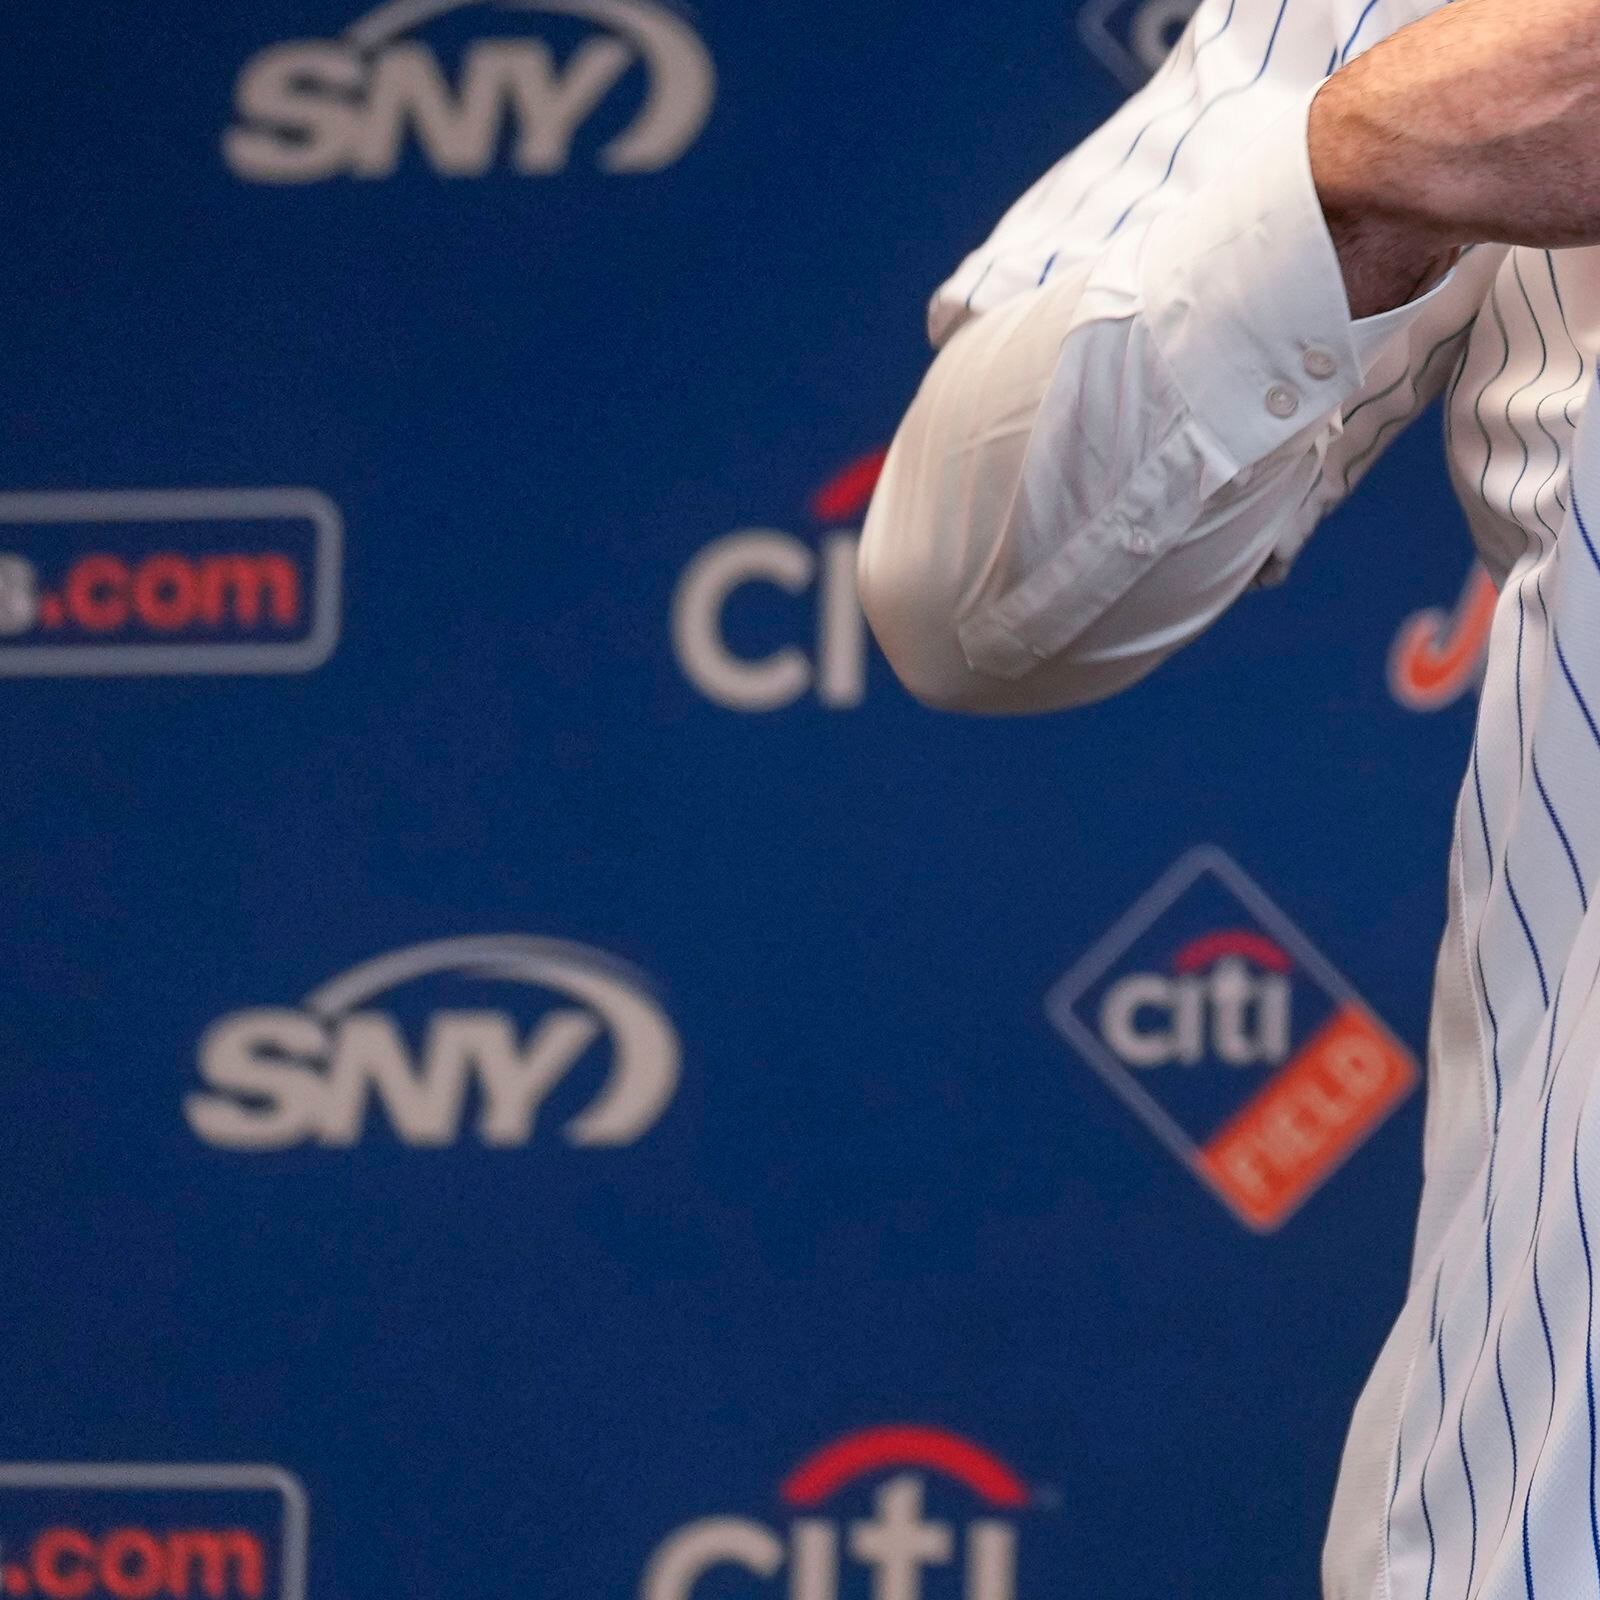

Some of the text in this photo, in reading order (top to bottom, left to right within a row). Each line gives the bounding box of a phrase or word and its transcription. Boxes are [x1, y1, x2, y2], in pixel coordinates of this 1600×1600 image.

[222, 37, 633, 181] SNY
[185, 1006, 601, 1148] SNY
[1100, 955, 1292, 1066] citi
